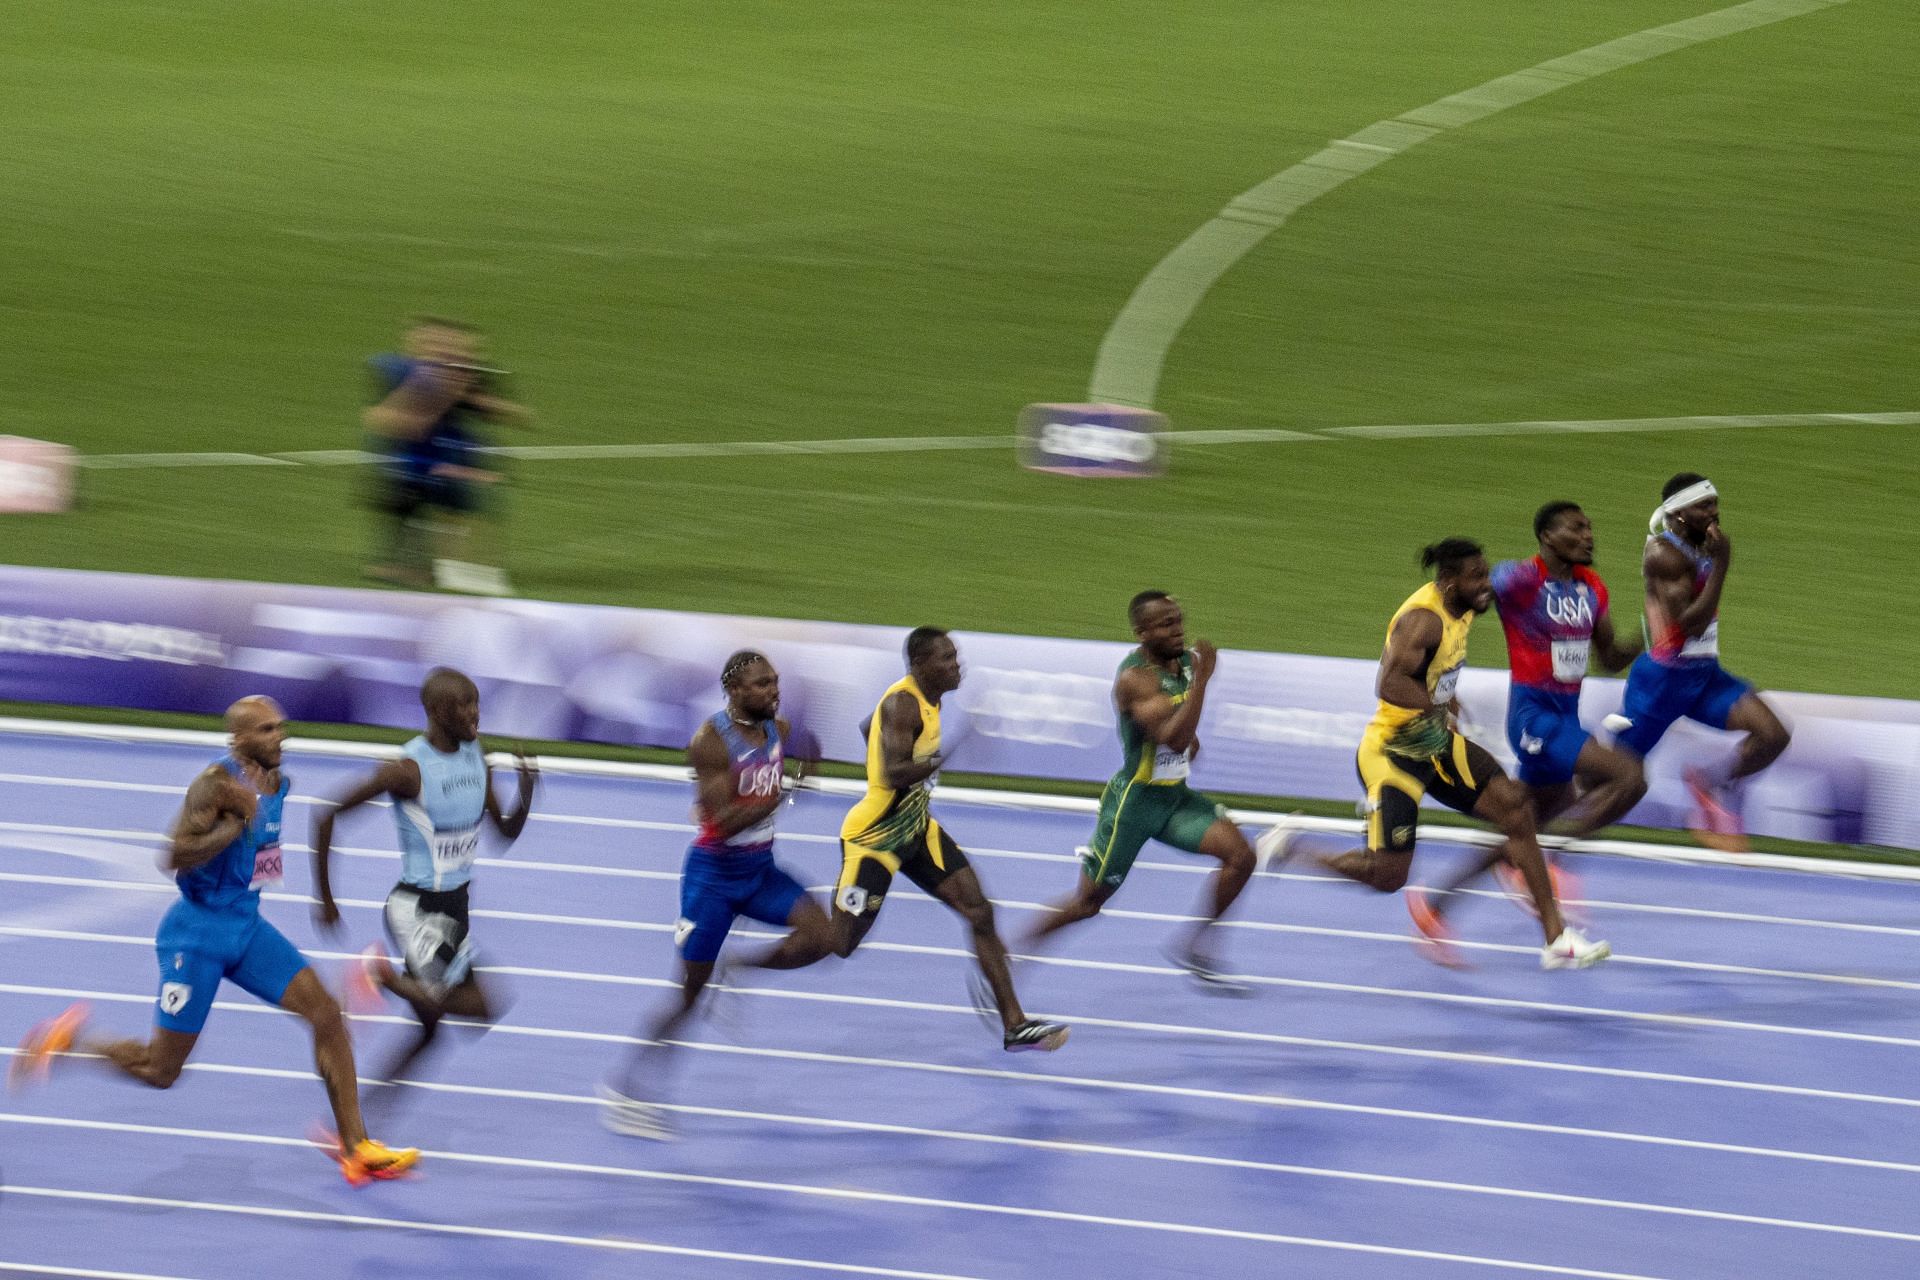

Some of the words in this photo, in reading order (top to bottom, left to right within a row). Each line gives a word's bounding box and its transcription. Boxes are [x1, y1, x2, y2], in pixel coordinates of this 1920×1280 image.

[1546, 592, 1594, 629] USA
[738, 761, 781, 798] USA
[167, 991, 179, 1007] 9
